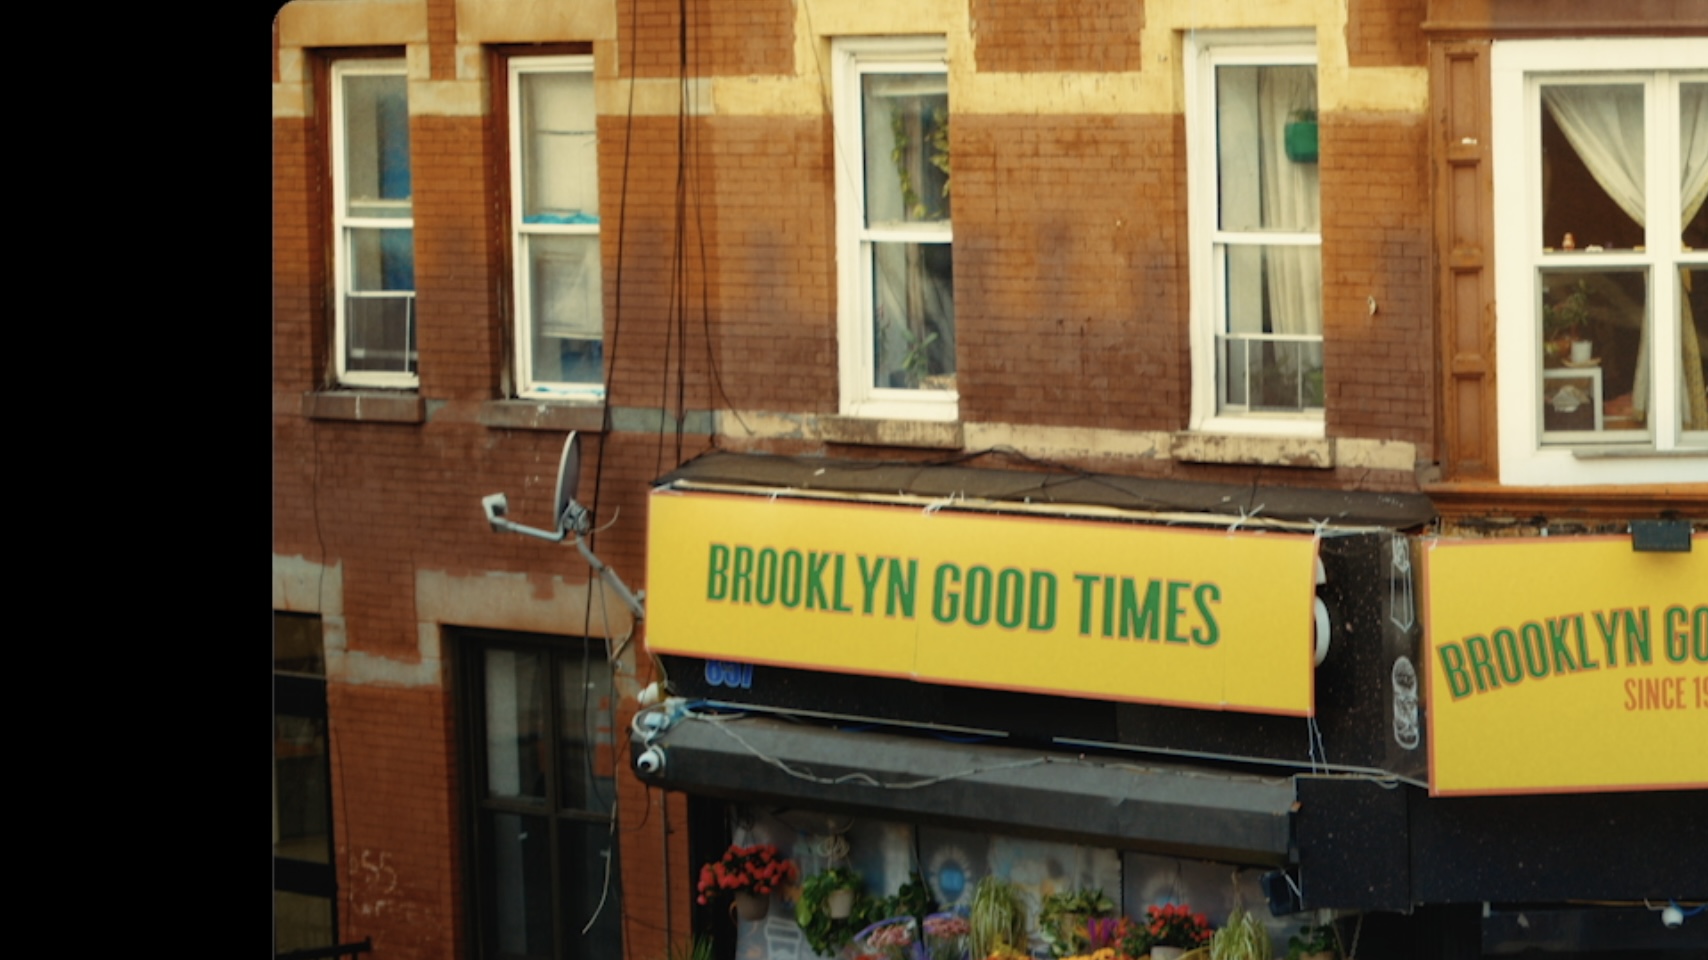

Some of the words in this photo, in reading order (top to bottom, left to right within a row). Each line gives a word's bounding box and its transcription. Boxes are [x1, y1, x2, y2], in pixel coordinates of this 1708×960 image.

[706, 543, 918, 619] BROOKLYN
[930, 562, 1058, 633] GOOD
[1073, 572, 1222, 648] TIMES
[1436, 607, 1652, 703] BROOKLYN
[1624, 677, 1687, 711] SINCE
